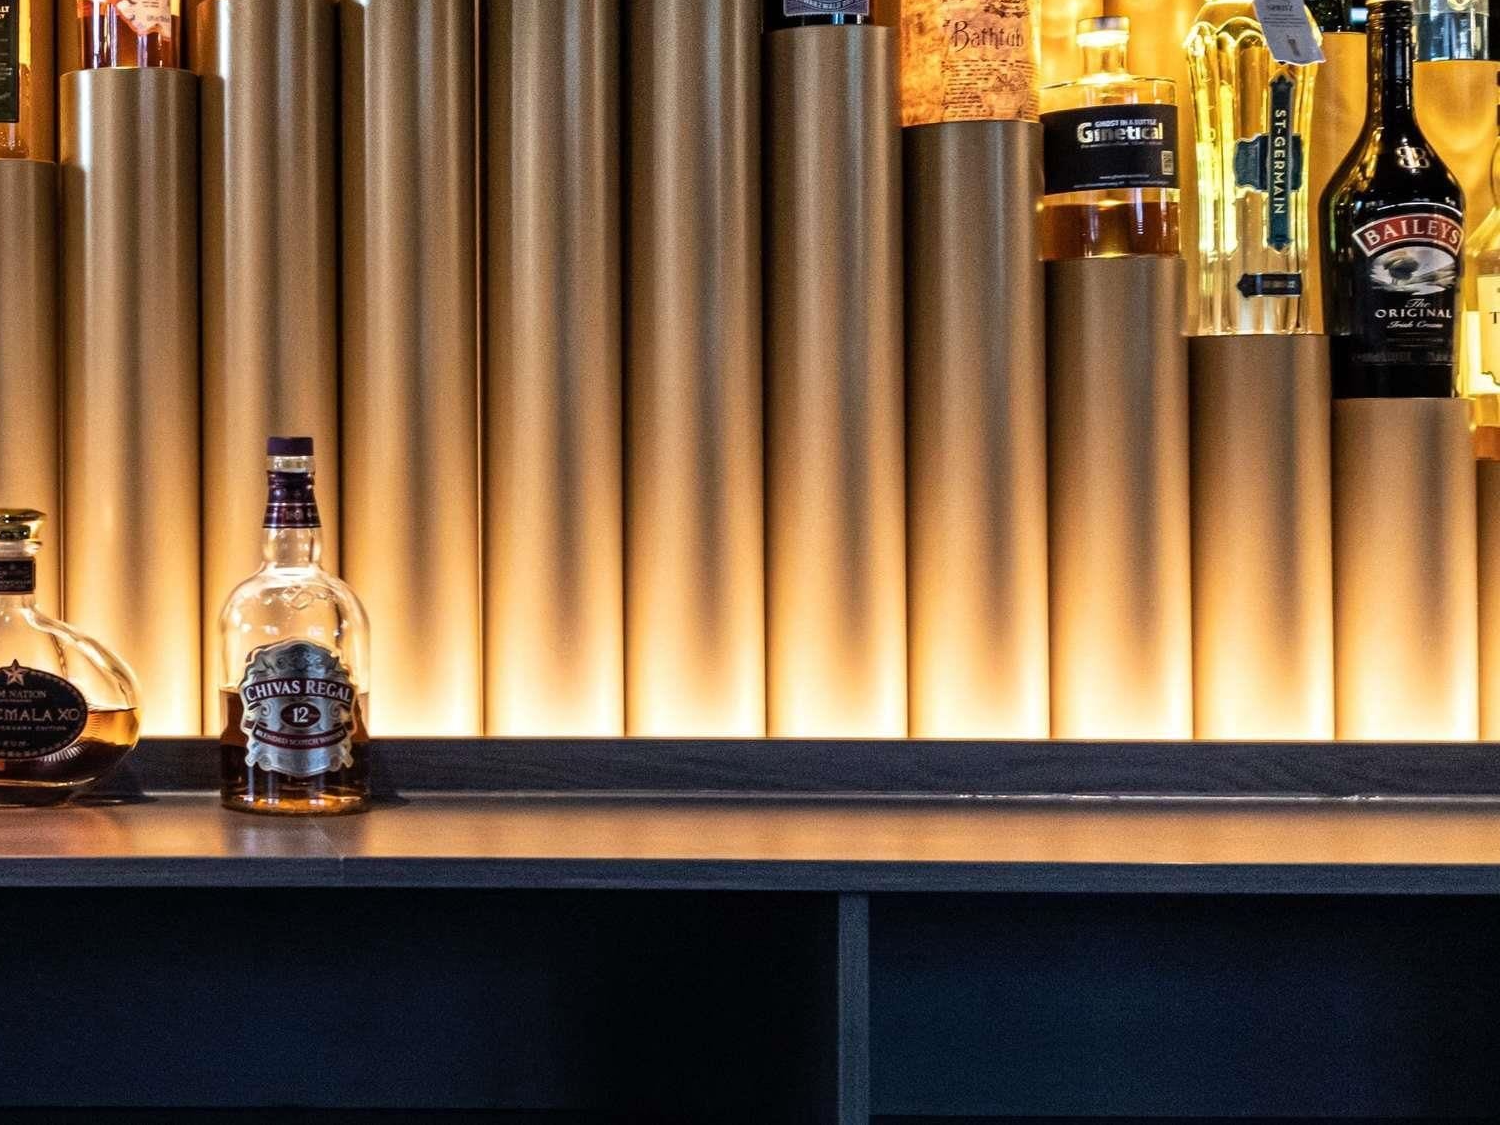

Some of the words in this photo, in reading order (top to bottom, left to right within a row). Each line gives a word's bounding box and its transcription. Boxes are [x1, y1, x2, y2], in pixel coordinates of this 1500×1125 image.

[951, 20, 1025, 52] Bathtub
[1077, 122, 1164, 143] Ginetical
[1273, 109, 1287, 214] ST-GERMAIN
[1363, 219, 1460, 247] BAILEYS
[1405, 298, 1431, 309] The
[1374, 308, 1453, 319] ORIGINAL
[8, 689, 47, 699] NATION
[245, 679, 300, 701] CHIVAS
[306, 679, 351, 702] REGAL
[58, 708, 81, 721] XO
[292, 706, 309, 723] 12
